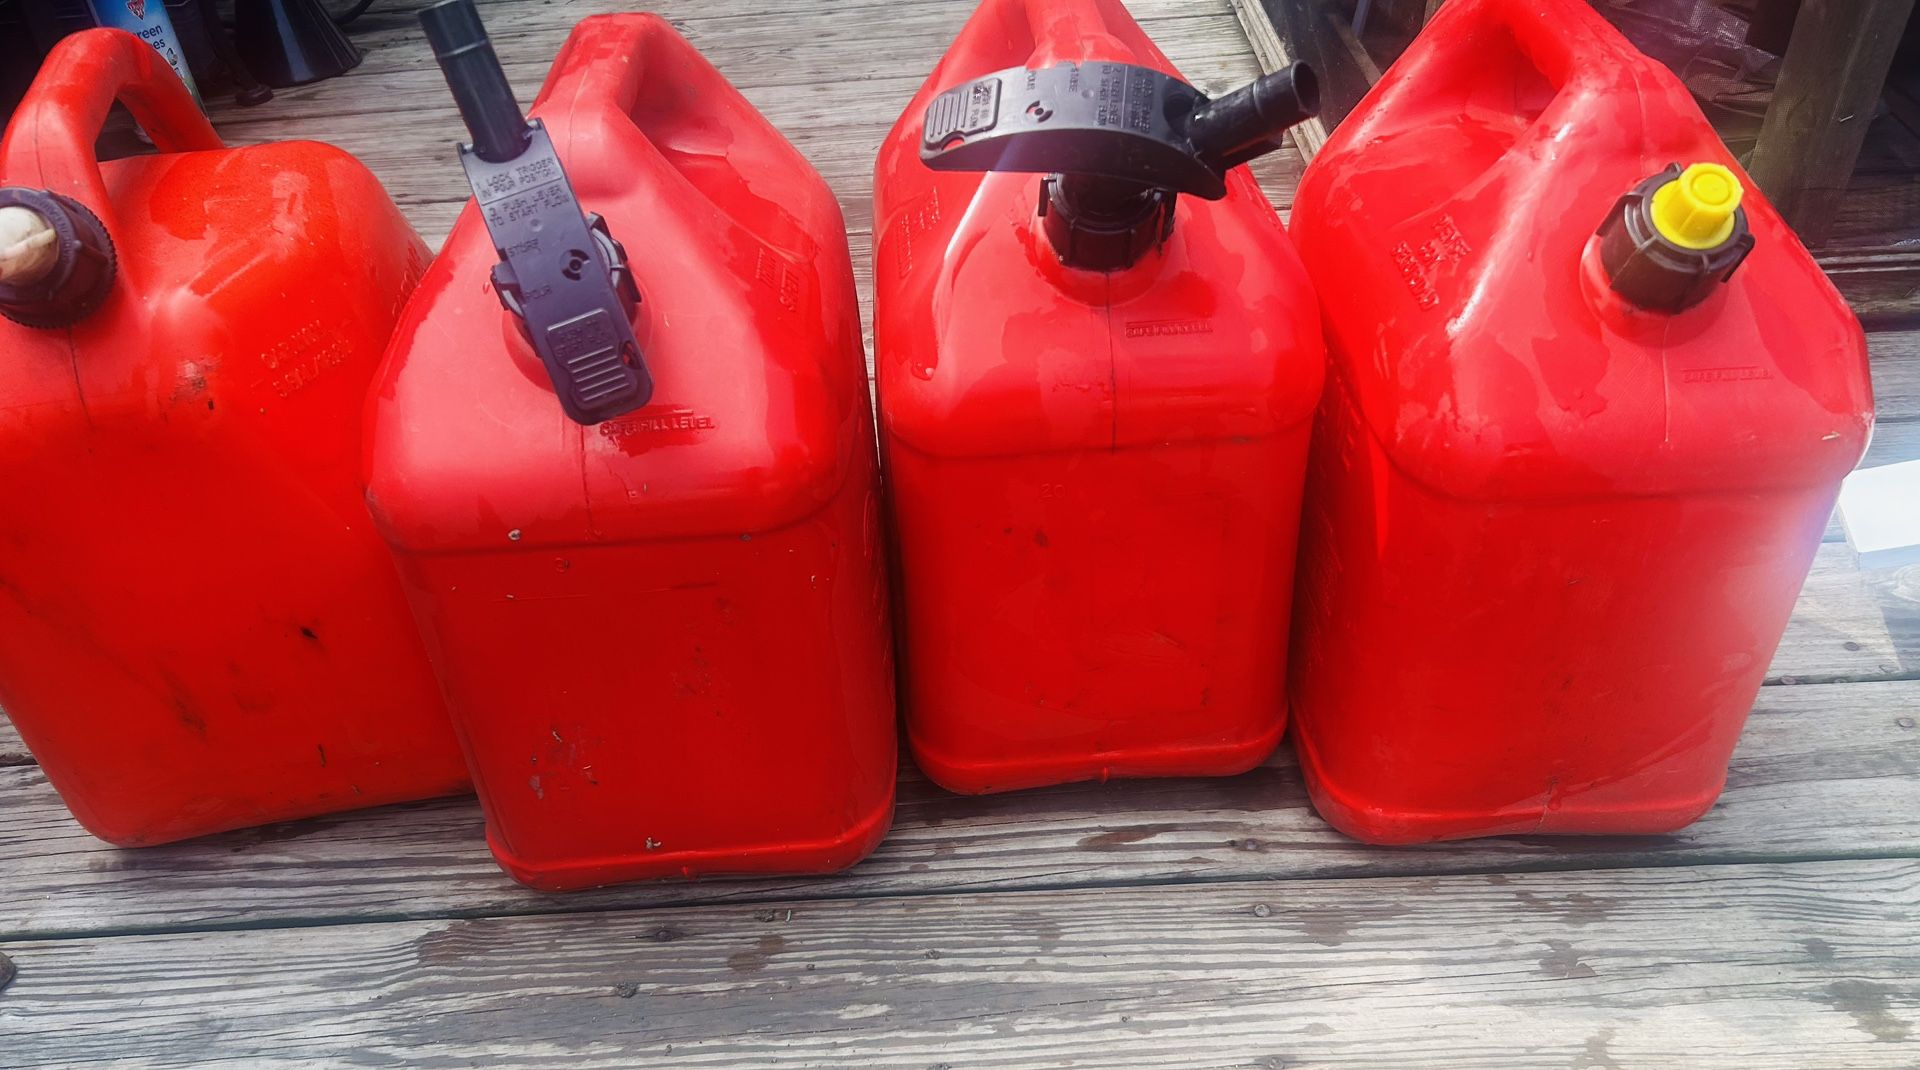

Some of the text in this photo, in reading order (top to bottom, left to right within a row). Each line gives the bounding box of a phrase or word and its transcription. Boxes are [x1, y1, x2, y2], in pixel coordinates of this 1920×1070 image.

[134, 25, 163, 40] reen
[486, 171, 513, 188] LOCK
[515, 157, 555, 177] TRIGGER
[493, 179, 516, 193] POUR
[489, 216, 505, 228] TO
